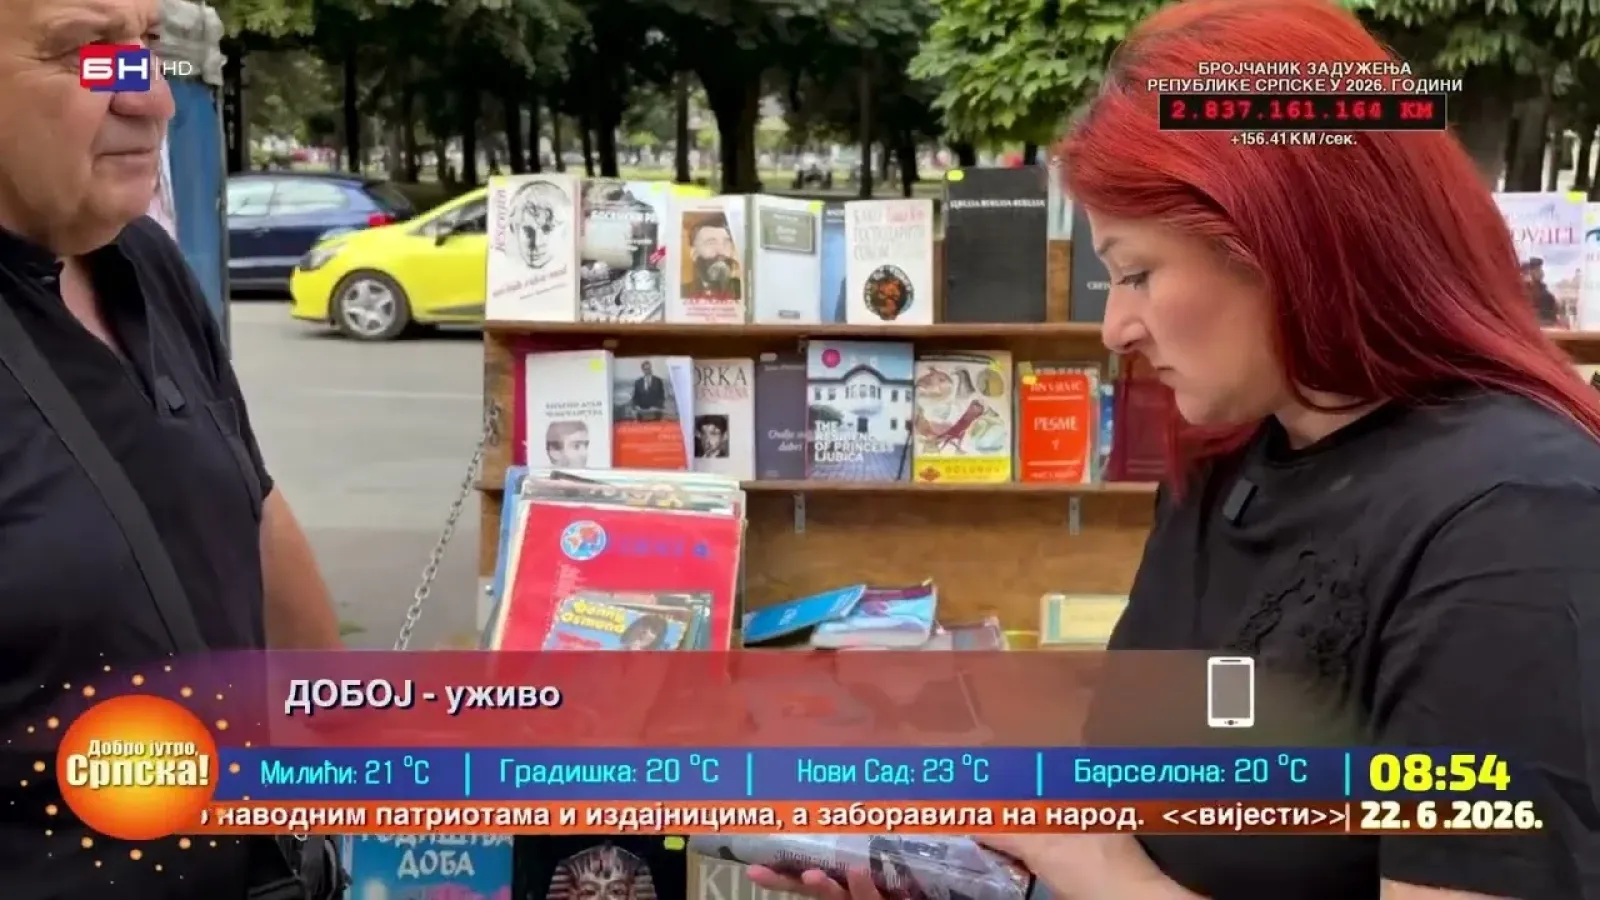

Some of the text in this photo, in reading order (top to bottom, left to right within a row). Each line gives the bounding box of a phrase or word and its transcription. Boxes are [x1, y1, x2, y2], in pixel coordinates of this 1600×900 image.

[815, 420, 839, 431] THE
[1033, 416, 1078, 431] PESME
[815, 441, 832, 452] OF
[397, 850, 475, 879] ДОБА
